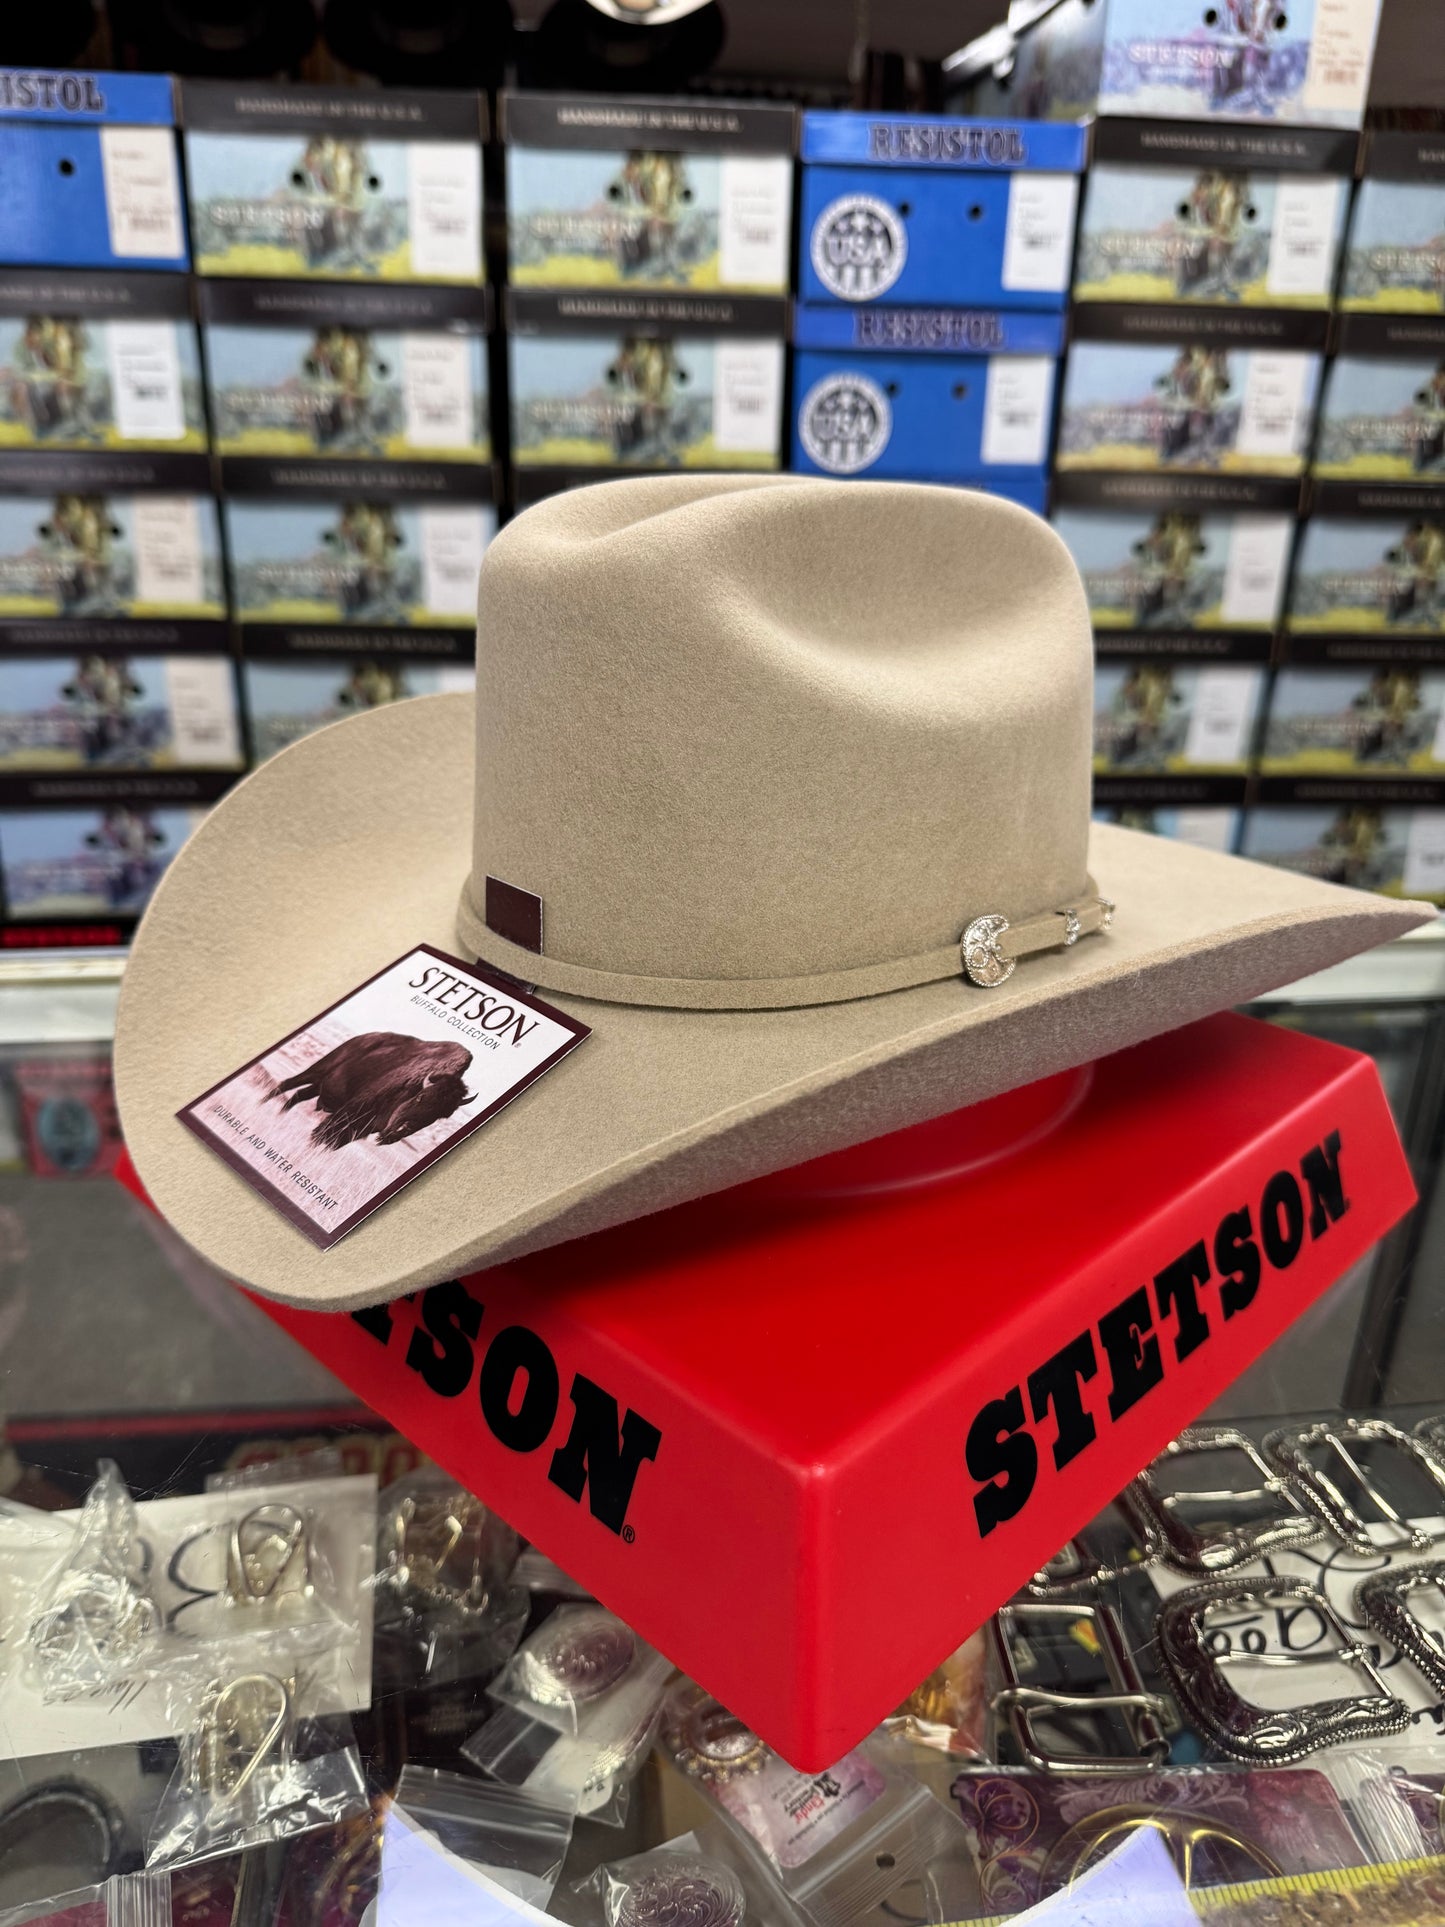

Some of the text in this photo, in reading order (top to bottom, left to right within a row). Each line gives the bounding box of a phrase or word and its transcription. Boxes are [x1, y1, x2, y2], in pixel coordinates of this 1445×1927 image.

[872, 126, 1024, 163] RESISTOL
[409, 967, 540, 1045] STETSON
[411, 995, 500, 1050] BUFFALO COLLECTION
[213, 1105, 338, 1210] DURABLE AND WATER RESISTANT
[965, 1129, 1346, 1539] STETSON
